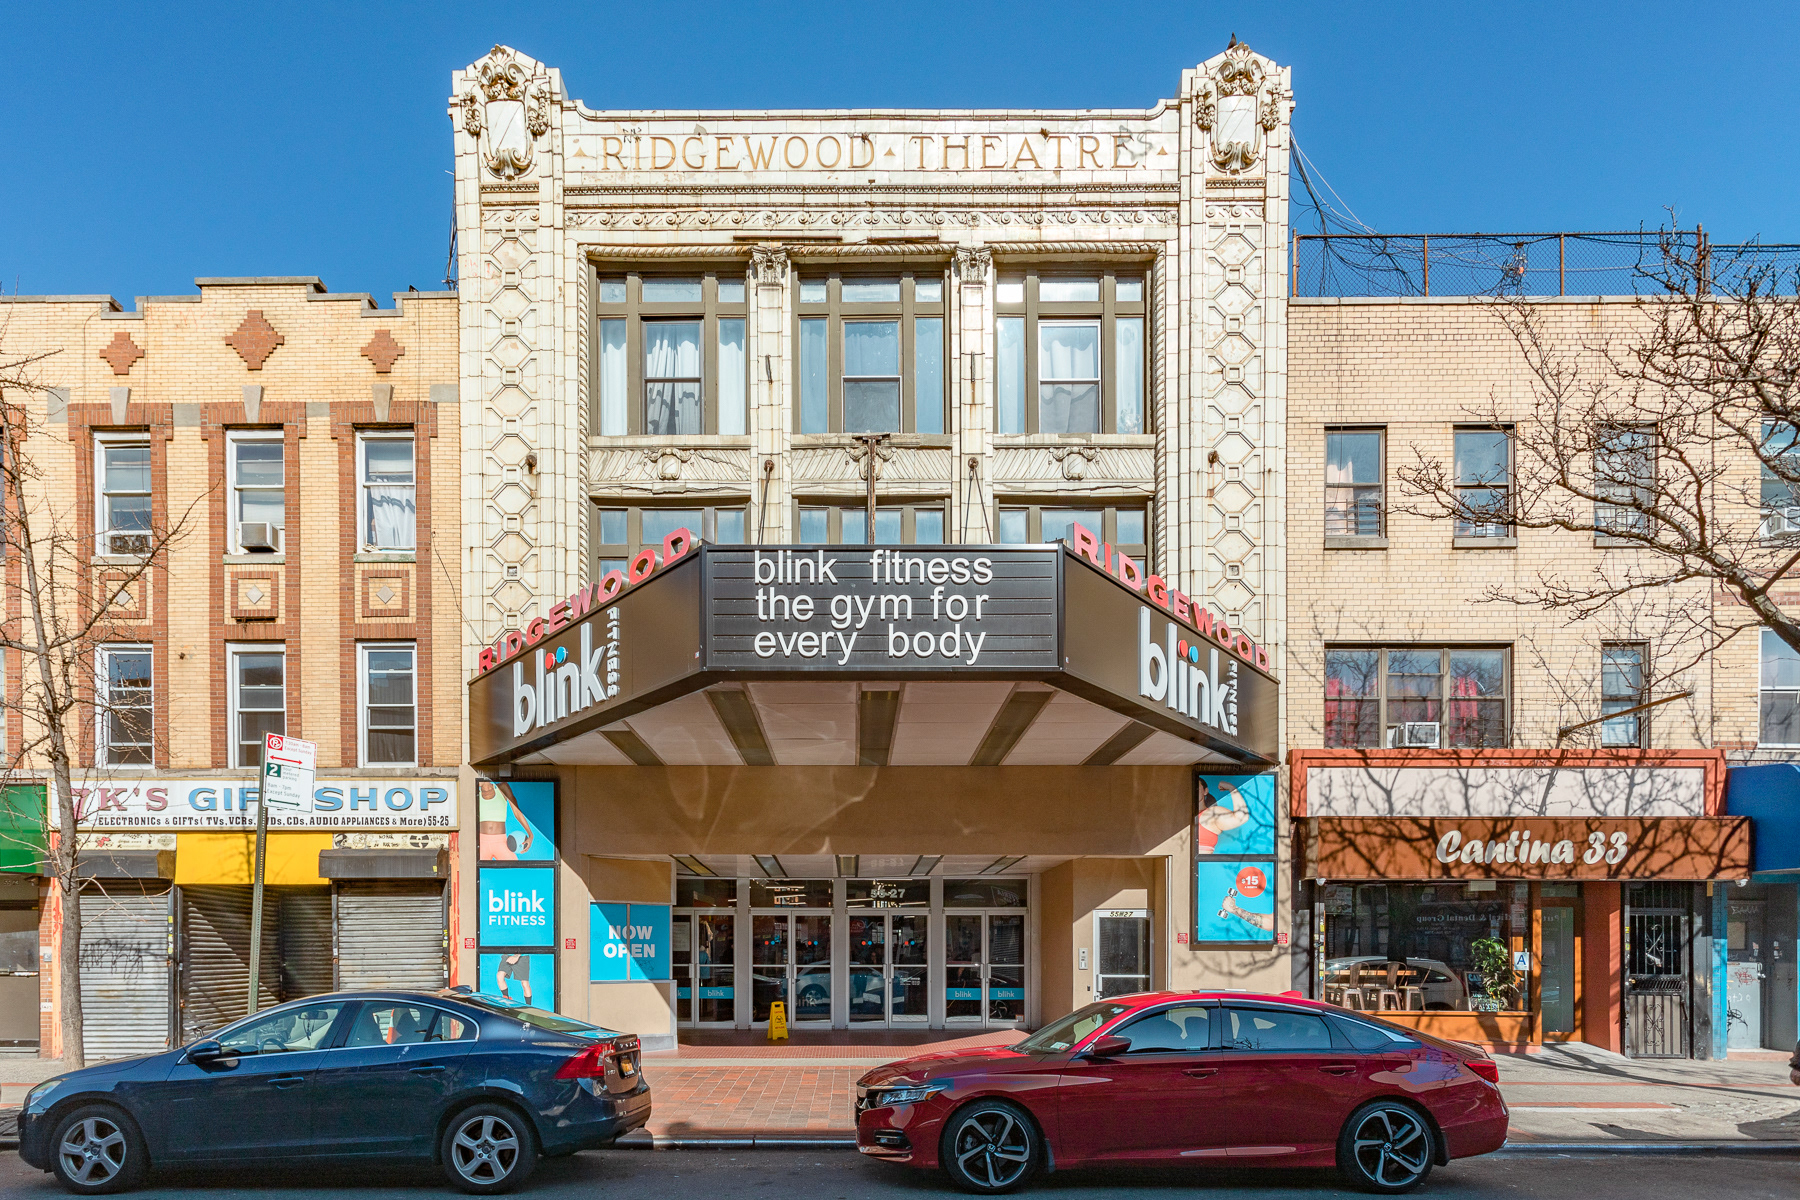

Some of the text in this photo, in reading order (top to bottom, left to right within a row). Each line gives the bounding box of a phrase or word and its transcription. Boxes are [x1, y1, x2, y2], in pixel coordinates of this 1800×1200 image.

[600, 135, 875, 170] RIDGEWOOD
[909, 134, 1141, 170] THEATRE
[753, 550, 993, 585] blink fitness
[478, 526, 692, 675] RIDGEWOOD
[755, 586, 990, 630] the gym for
[1073, 521, 1270, 673] RIDGEWOOD
[606, 606, 621, 698] FITNESS
[753, 623, 987, 666] every body
[513, 621, 610, 737] blink
[1138, 605, 1231, 735] blink
[268, 763, 278, 777] 2
[188, 787, 260, 812] GIF
[314, 786, 448, 811] SHOP
[309, 816, 339, 826] AUDIO
[340, 816, 390, 826] APPLIANCES
[1435, 829, 1628, 865] Cantina 33
[488, 889, 545, 912] blink
[488, 915, 546, 926] FITNESS
[608, 924, 653, 940] NOW
[603, 942, 656, 958] OPEN
[1516, 954, 1527, 966] A
[954, 990, 972, 998] blink
[998, 990, 1015, 998] blink
